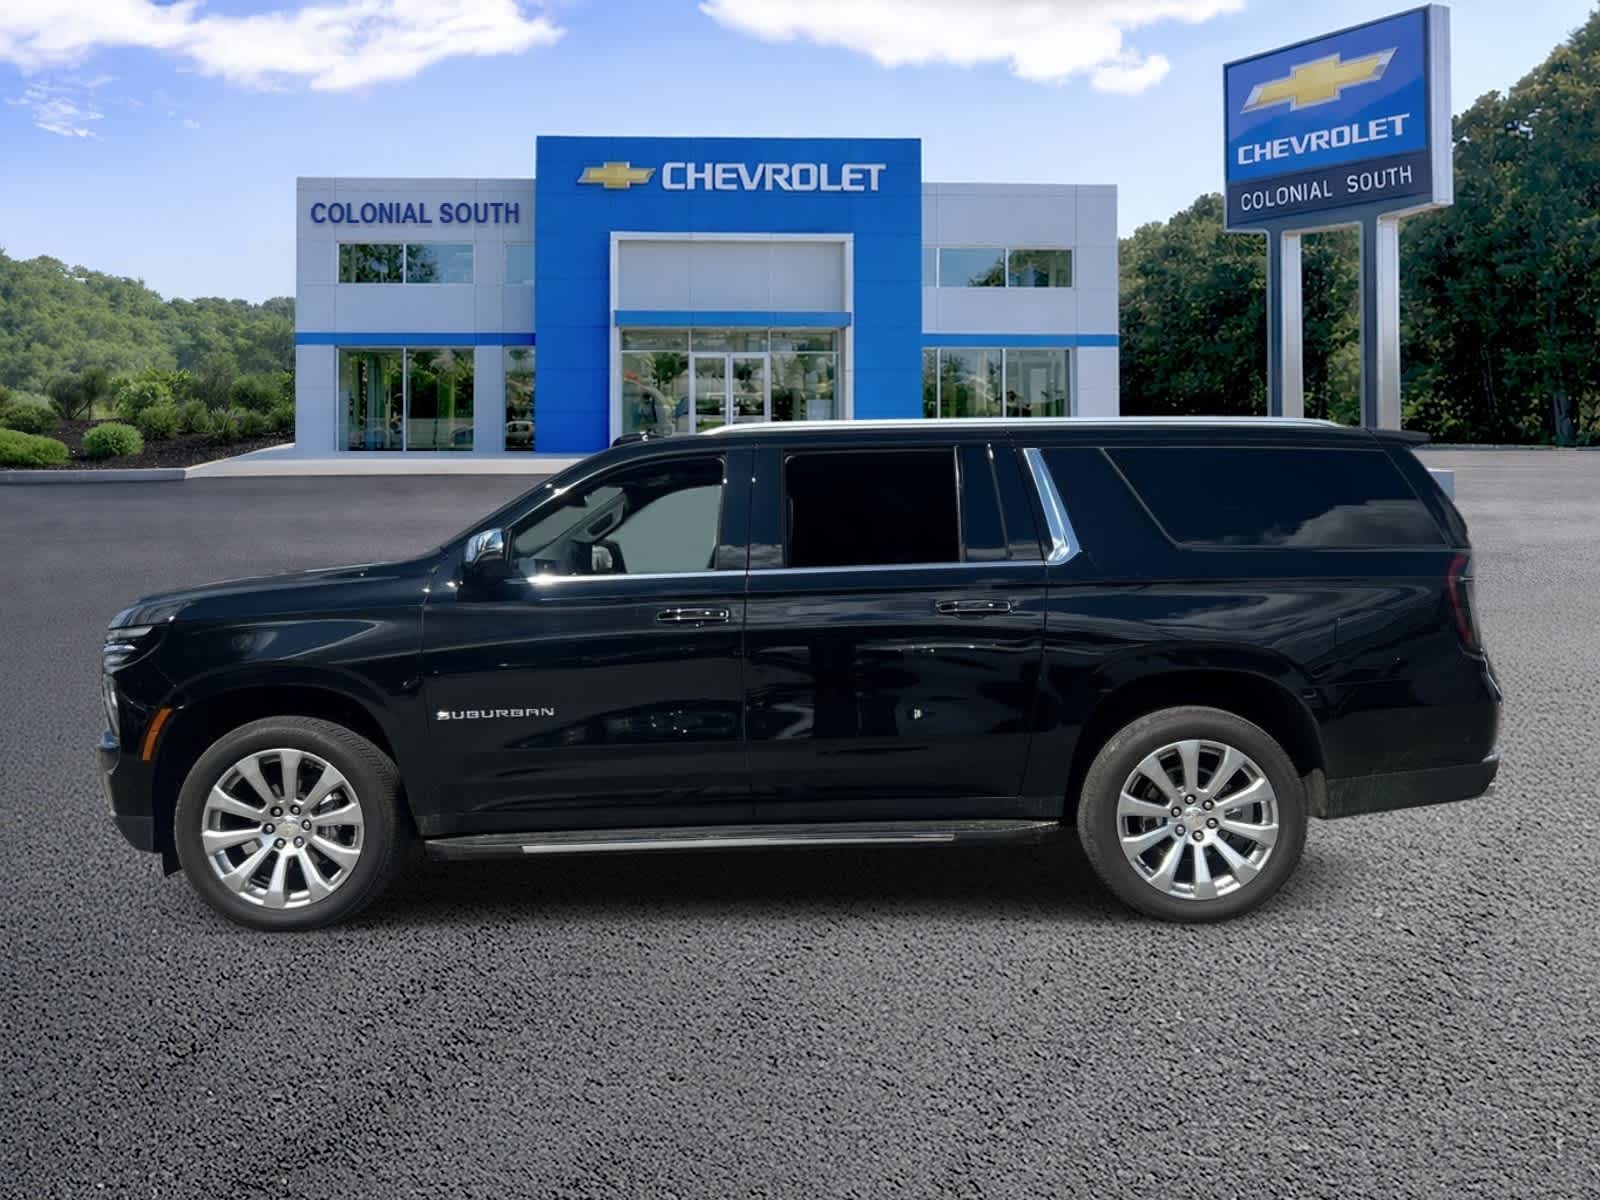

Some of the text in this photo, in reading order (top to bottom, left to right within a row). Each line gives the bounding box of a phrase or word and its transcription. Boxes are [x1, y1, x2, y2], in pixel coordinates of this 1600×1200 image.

[1238, 113, 1410, 165] CHEVROLET
[661, 162, 887, 192] CHEVROLET
[1240, 165, 1413, 211] COLONIAL SOUTH
[310, 203, 520, 225] COLONIAL SOUTH
[436, 707, 555, 721] SUBURBAN
